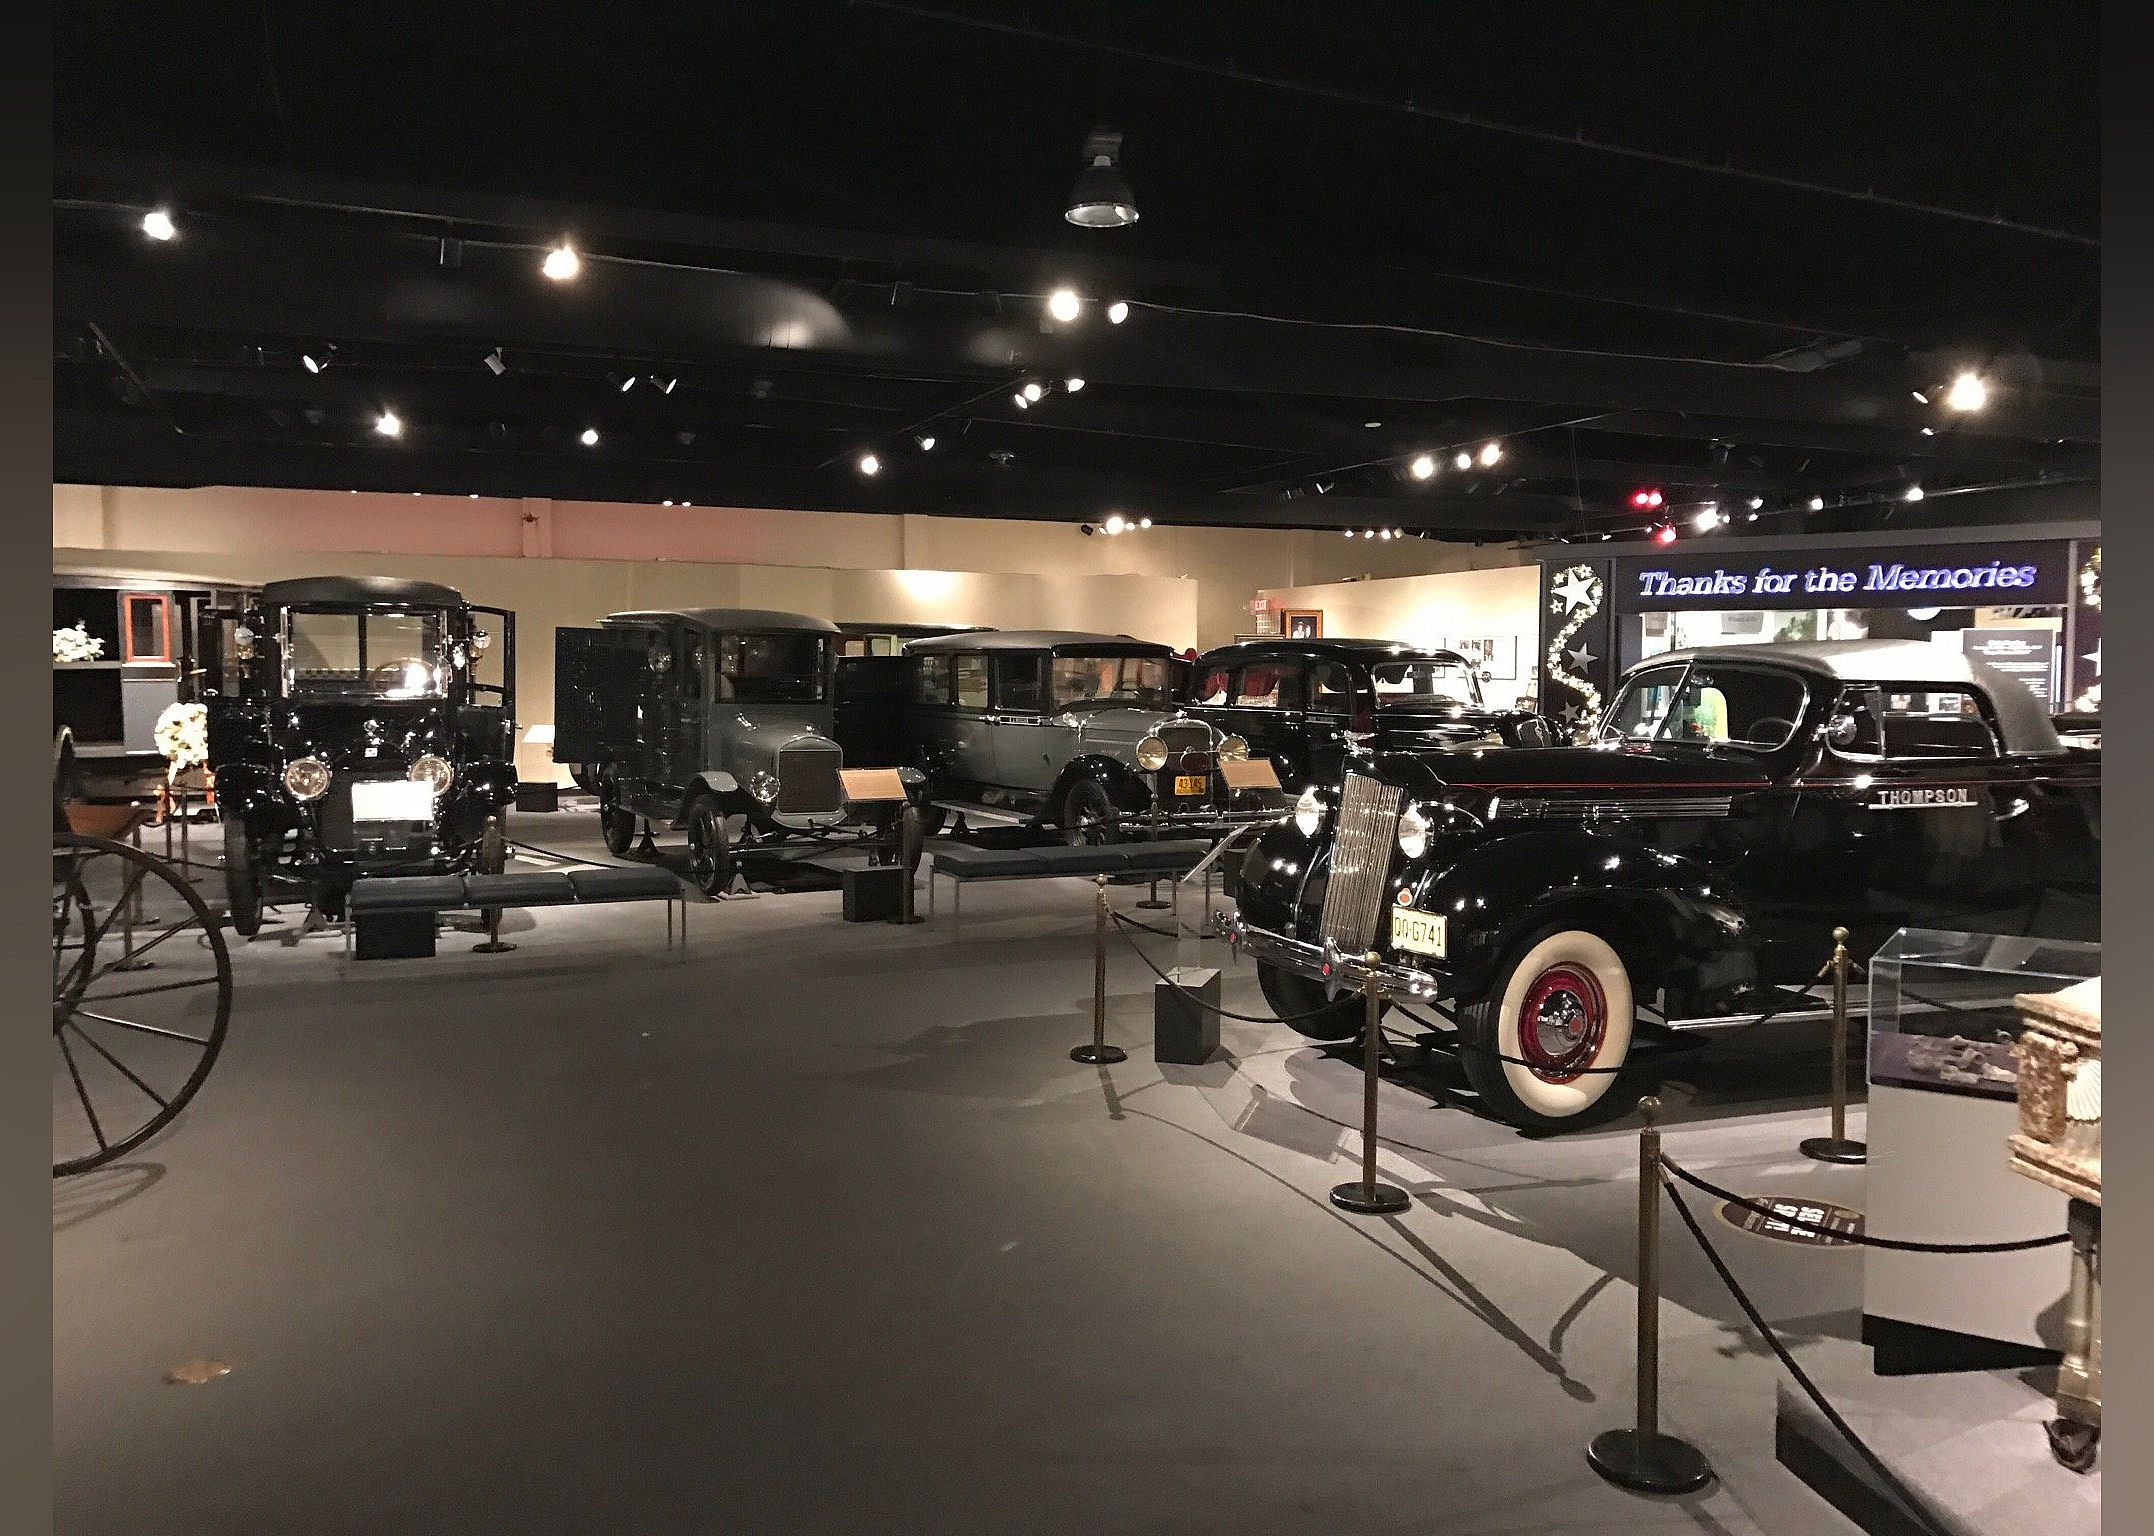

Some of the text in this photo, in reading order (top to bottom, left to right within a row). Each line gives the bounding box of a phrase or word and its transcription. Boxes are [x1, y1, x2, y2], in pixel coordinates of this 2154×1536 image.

[1639, 560, 2037, 596] Thanks for the Memories
[1877, 788, 1968, 804] THOMPSON
[1790, 1206, 1825, 1238] SELE
